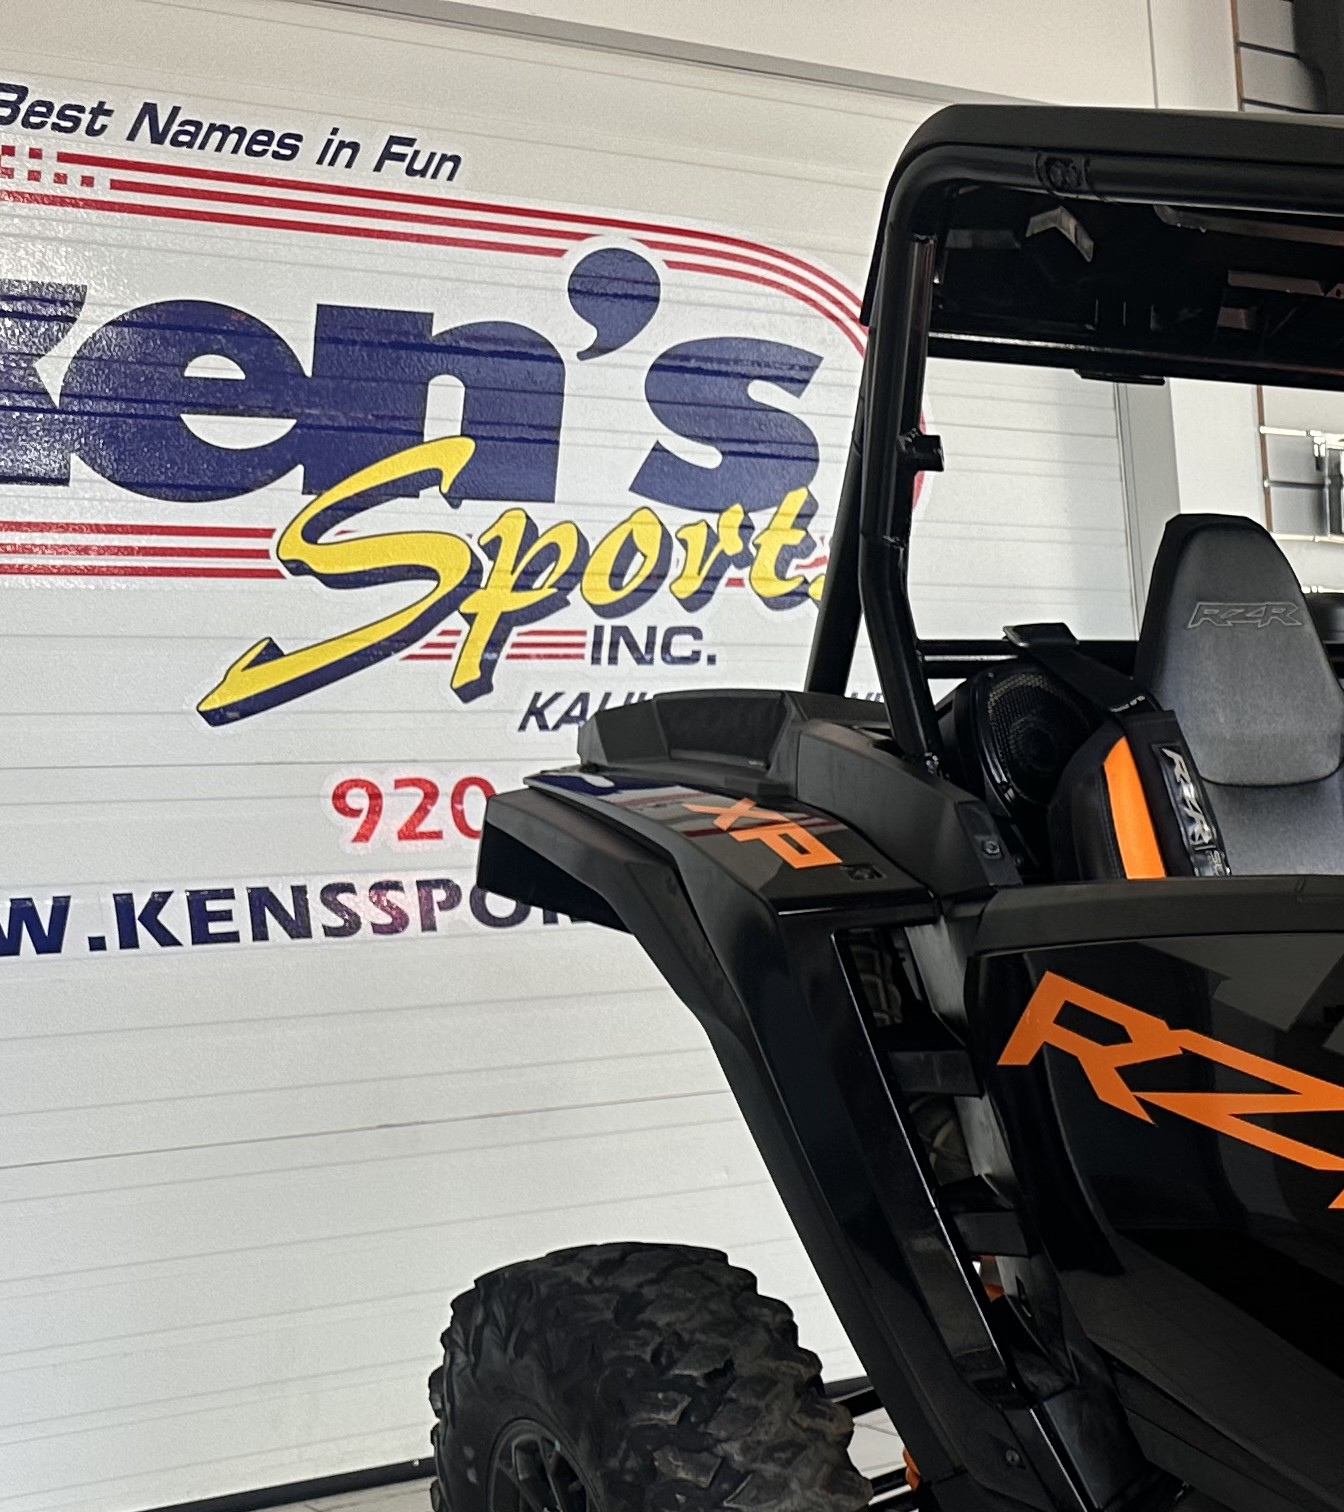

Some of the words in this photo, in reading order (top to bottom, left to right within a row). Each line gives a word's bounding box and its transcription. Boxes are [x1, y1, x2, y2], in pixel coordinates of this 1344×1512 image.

[0, 82, 114, 138] Best
[126, 102, 304, 161] Names
[316, 127, 360, 169] in
[373, 135, 462, 182] Fun
[198, 436, 825, 727] Sport
[1187, 602, 1302, 629] RZR
[590, 624, 717, 666] INC.
[331, 776, 497, 844] 920
[682, 798, 844, 869] XP
